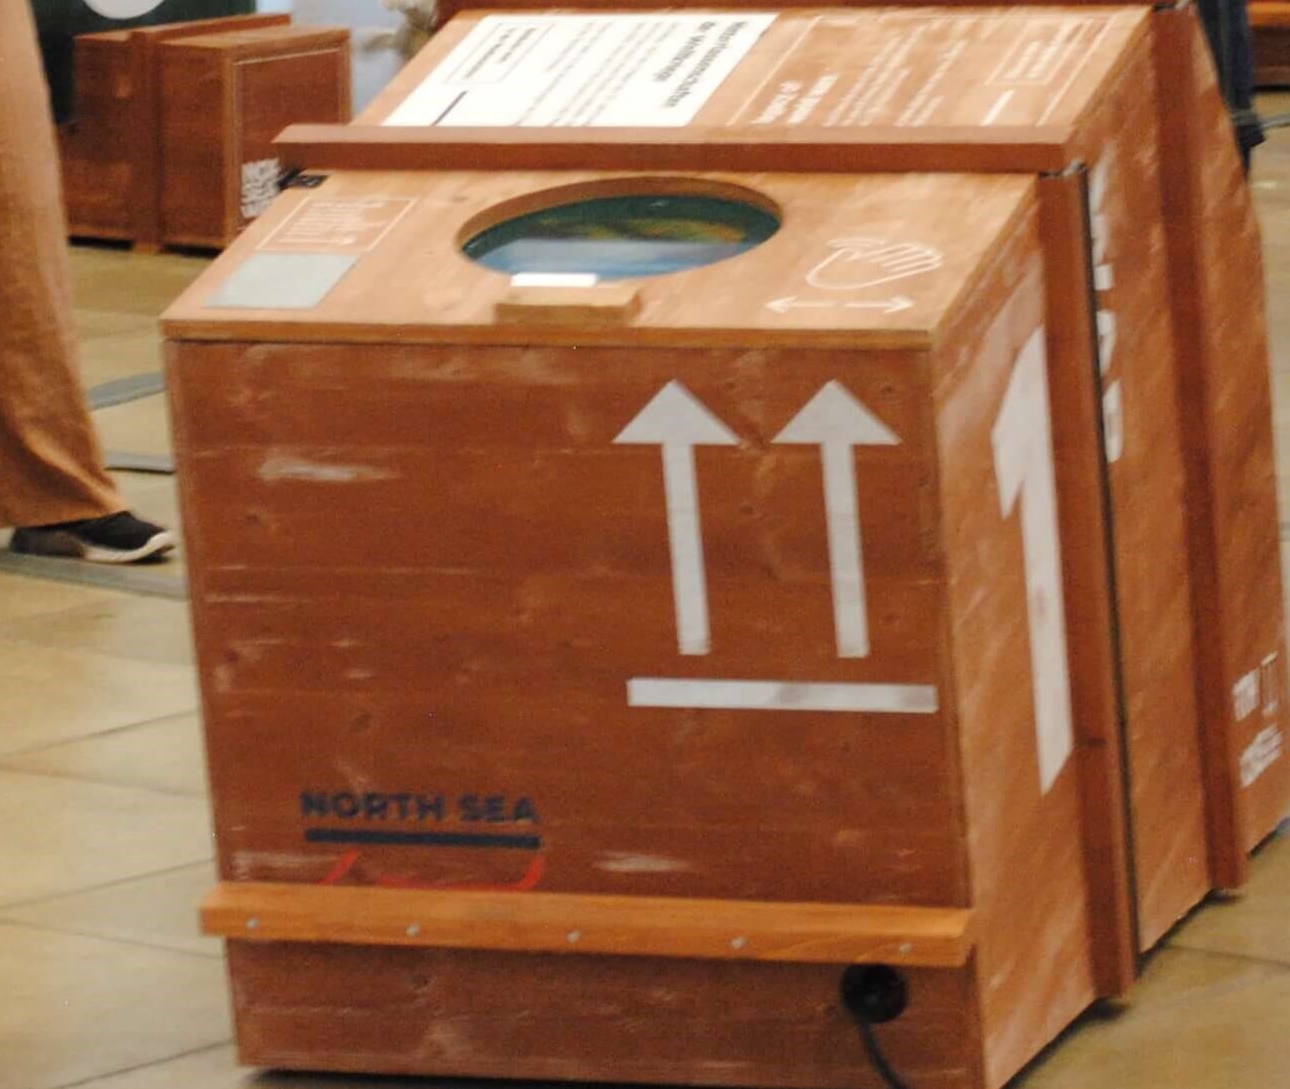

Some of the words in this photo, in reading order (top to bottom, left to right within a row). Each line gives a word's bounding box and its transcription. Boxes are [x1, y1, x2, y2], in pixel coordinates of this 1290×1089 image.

[991, 326, 1074, 797] 1
[300, 791, 445, 822] NORTH
[459, 794, 542, 823] SEA
